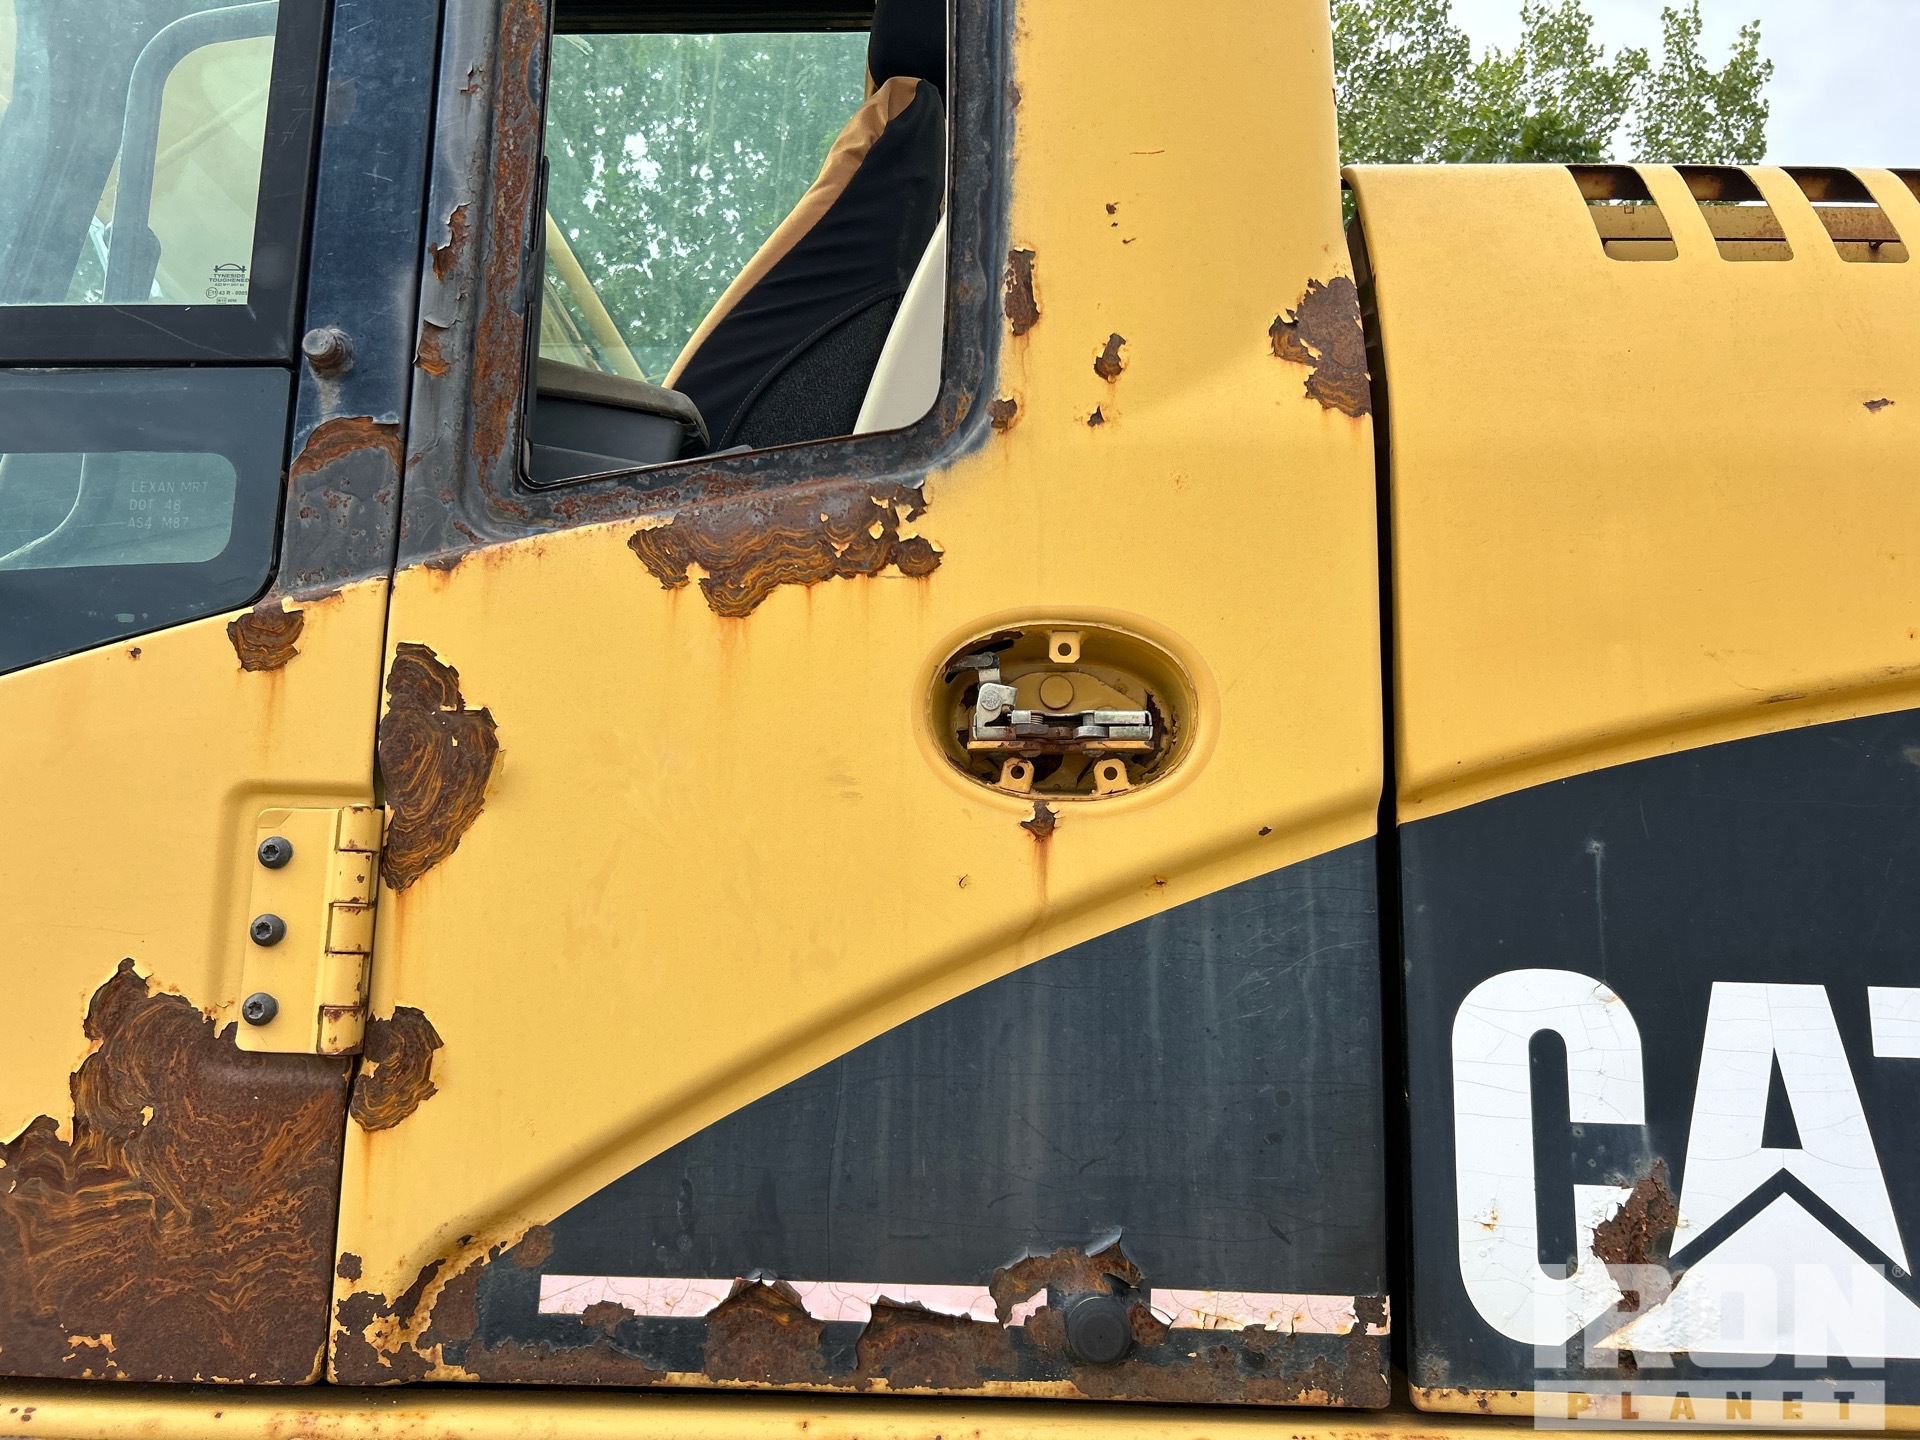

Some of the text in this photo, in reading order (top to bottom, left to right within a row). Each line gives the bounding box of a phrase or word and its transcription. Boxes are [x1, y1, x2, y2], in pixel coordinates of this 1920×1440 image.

[131, 481, 208, 493] LEXAN MRT
[129, 499, 155, 511] DOT
